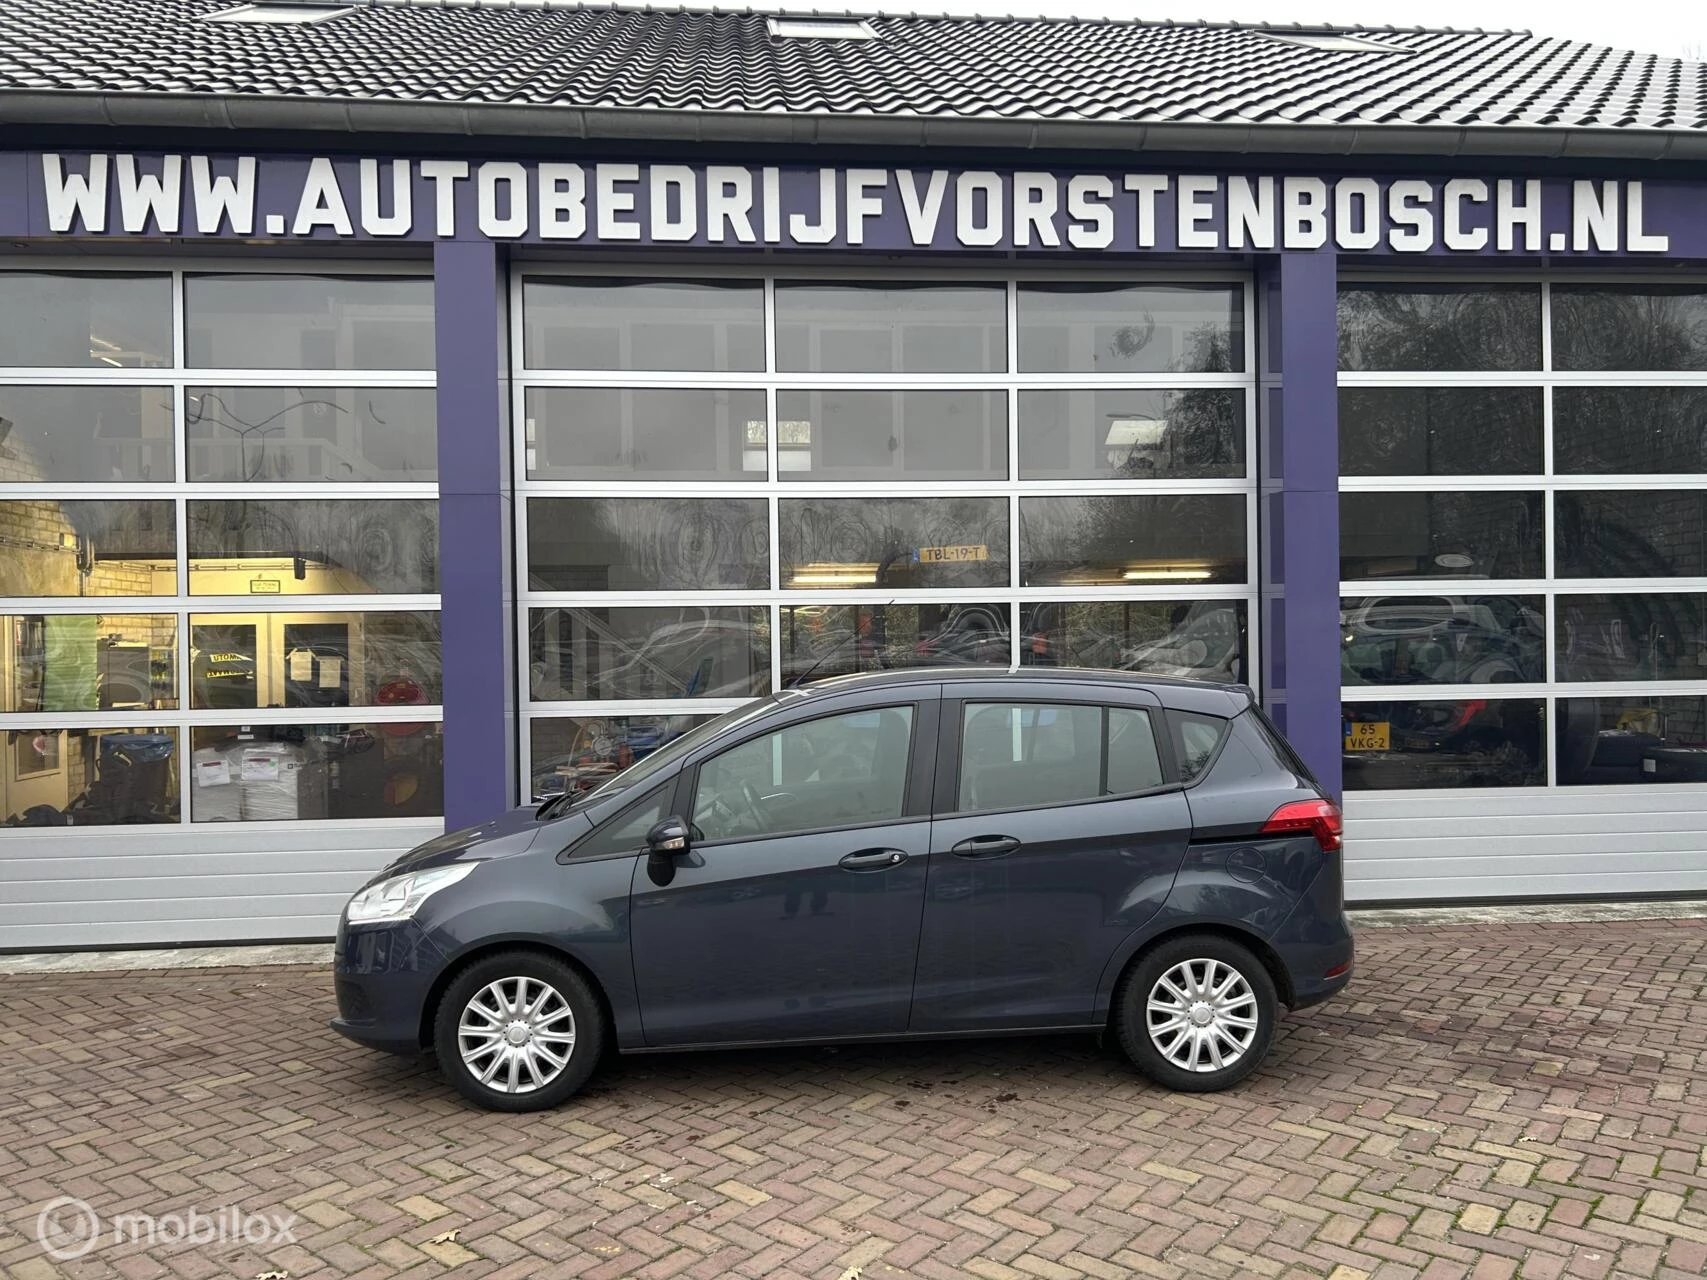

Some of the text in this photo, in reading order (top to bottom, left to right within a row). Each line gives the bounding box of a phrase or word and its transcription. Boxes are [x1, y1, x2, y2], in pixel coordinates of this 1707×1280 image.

[41, 153, 1669, 253] WWW.AUTOBEDRIJFVORSTENBOSCH.NL
[926, 546, 980, 560] TBL-19-T
[1360, 724, 1375, 735] 65
[1350, 737, 1385, 748] VKG-2
